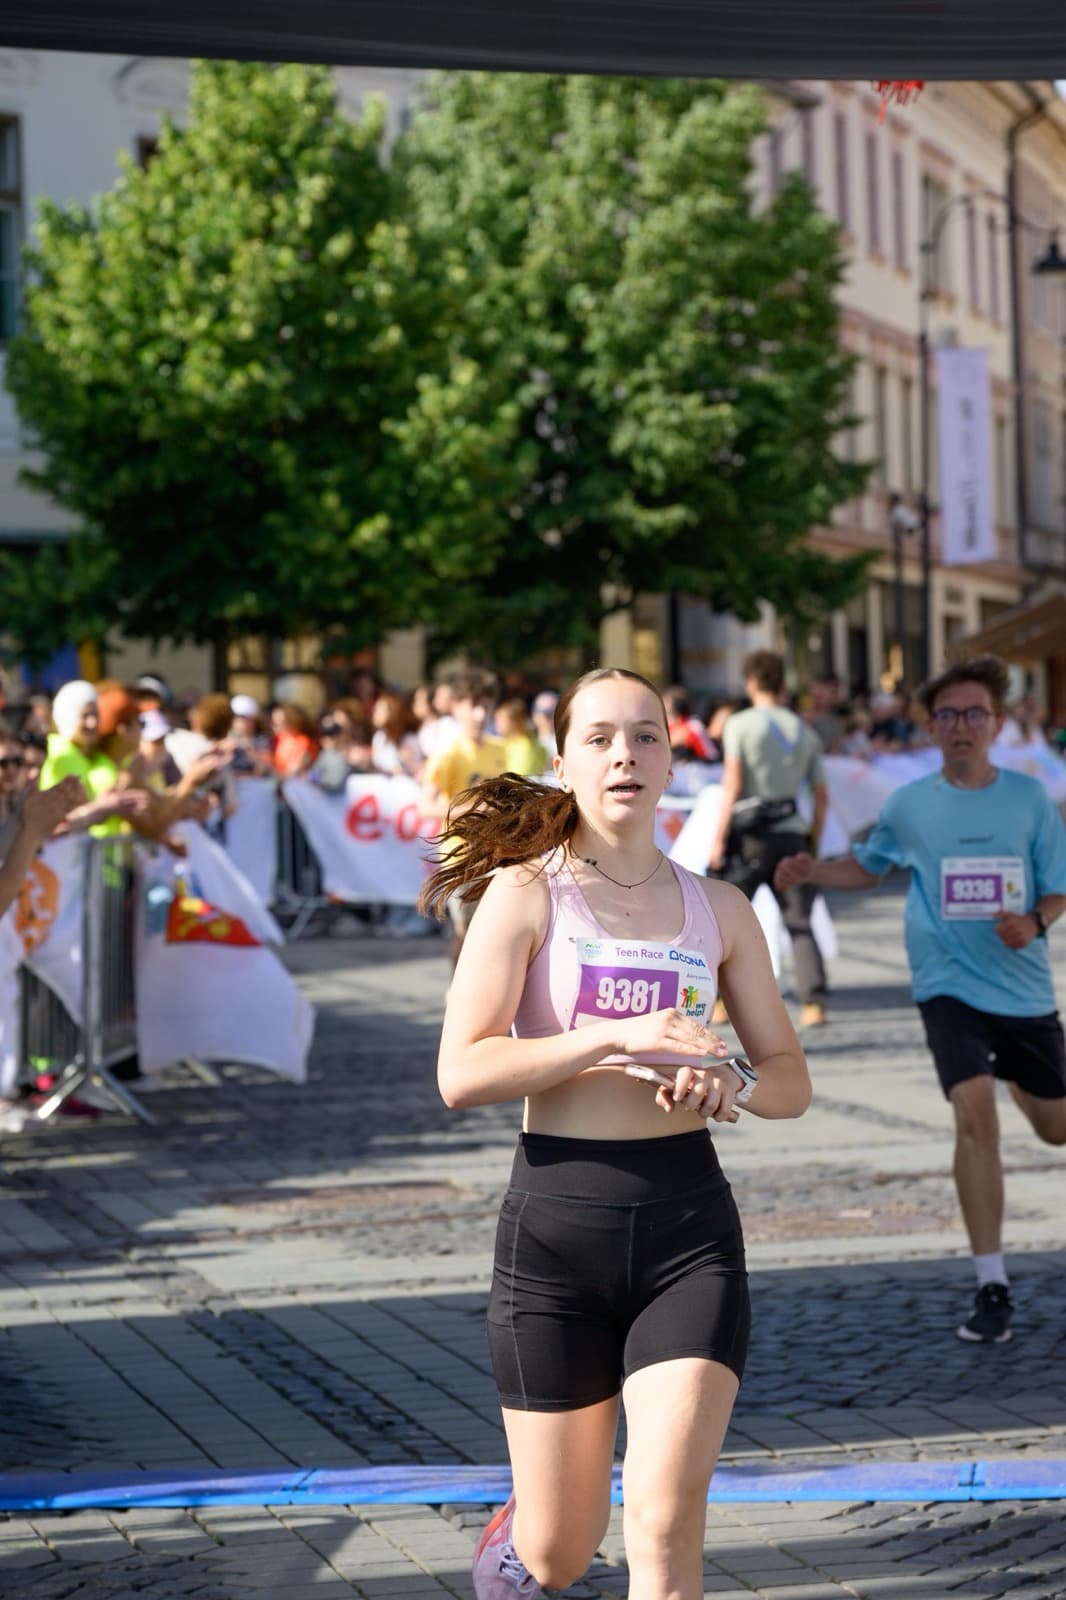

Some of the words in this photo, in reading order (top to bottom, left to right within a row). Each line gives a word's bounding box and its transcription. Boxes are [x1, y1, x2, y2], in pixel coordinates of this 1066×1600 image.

[615, 947, 639, 959] Teen
[640, 949, 664, 960] Race
[679, 953, 706, 968] CONA
[596, 977, 661, 1013] 9381
[686, 1009, 705, 1017] help!
